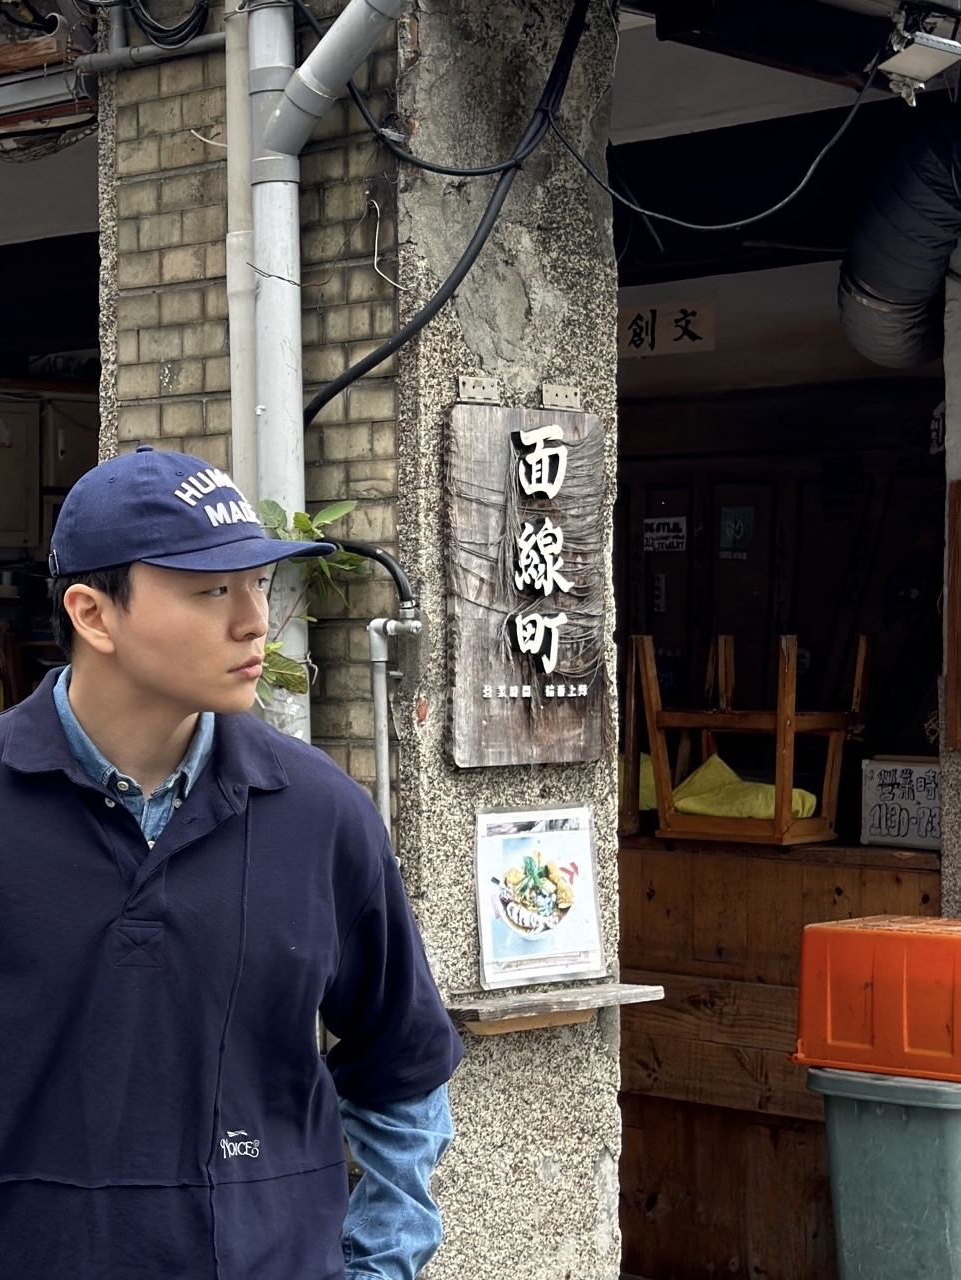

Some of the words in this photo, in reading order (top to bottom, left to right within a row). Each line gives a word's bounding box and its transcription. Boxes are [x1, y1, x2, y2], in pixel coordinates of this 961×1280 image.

[174, 468, 248, 507] HUM
[515, 424, 574, 675] 面線町
